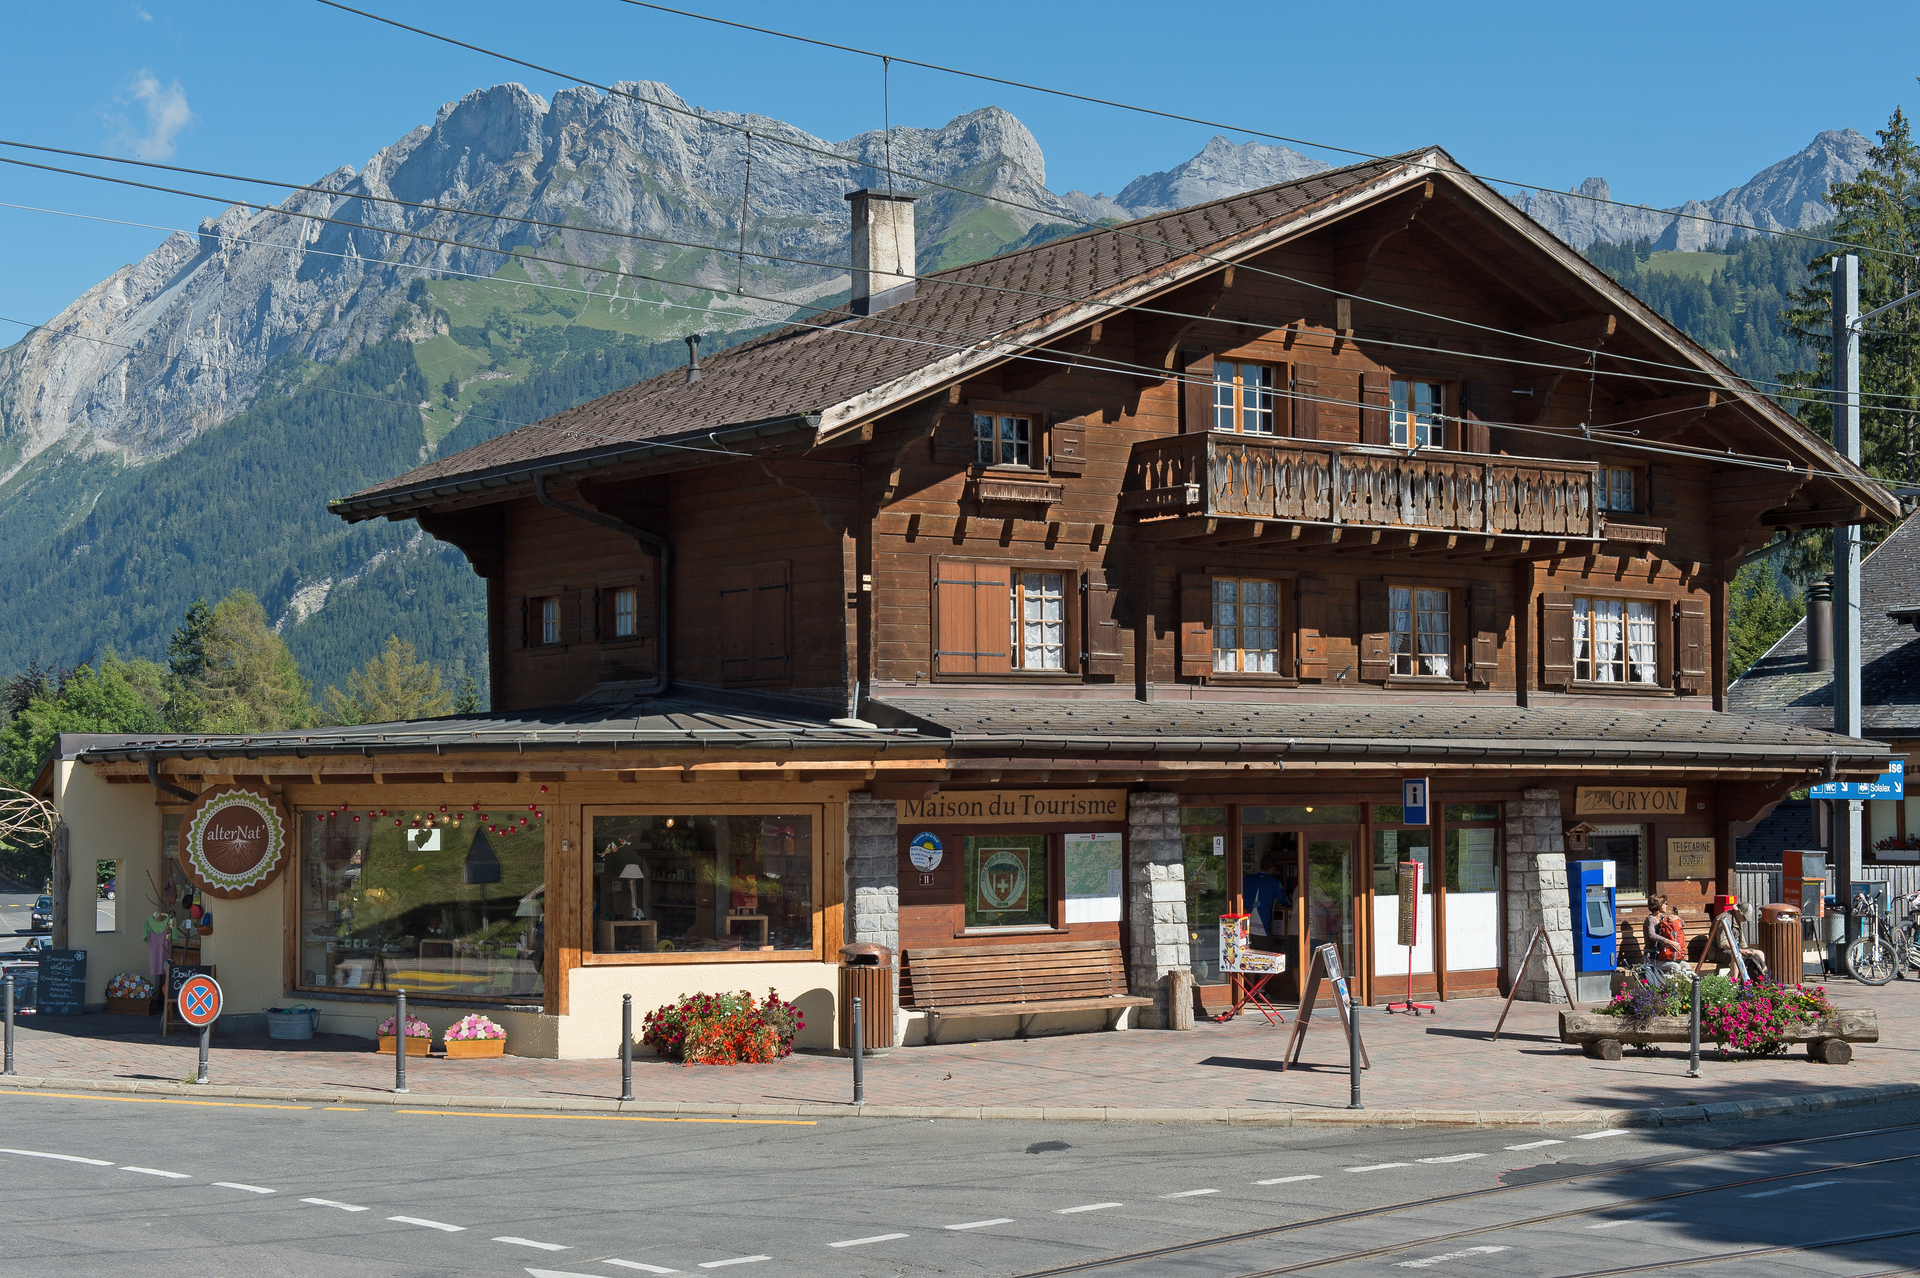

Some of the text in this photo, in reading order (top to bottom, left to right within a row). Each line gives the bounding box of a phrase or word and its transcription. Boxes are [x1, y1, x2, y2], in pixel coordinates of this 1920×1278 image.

[1825, 783, 1836, 791] WC
[1870, 783, 1890, 792] Solalex
[1611, 790, 1680, 810] GRYON
[903, 793, 1117, 818] Maison du Tourisme
[1672, 841, 1711, 852] TELECABINE
[1681, 856, 1704, 866] OUVERT
[923, 875, 929, 884] 11
